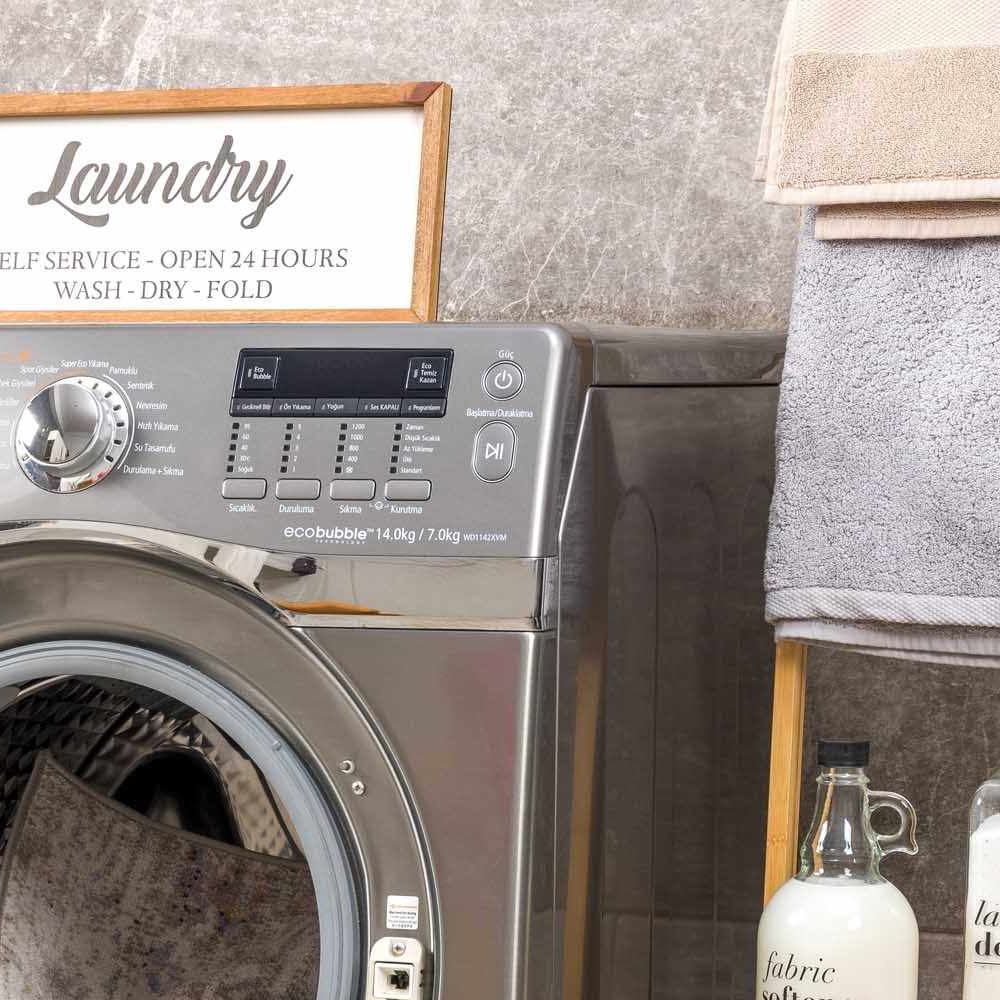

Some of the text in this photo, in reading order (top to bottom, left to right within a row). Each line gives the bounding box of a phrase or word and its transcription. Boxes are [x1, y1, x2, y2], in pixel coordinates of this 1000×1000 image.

[27, 133, 294, 229] Laundry
[43, 249, 141, 270] SERVICE
[160, 248, 226, 270] OPEN
[230, 248, 256, 269] 24
[260, 247, 349, 269] HOURS
[53, 280, 122, 300] WASH
[140, 279, 188, 300] DRY
[206, 278, 273, 300] FOLD
[376, 527, 416, 544] 14.0kg
[427, 528, 461, 544] 7.0kg
[762, 950, 836, 985] fabric
